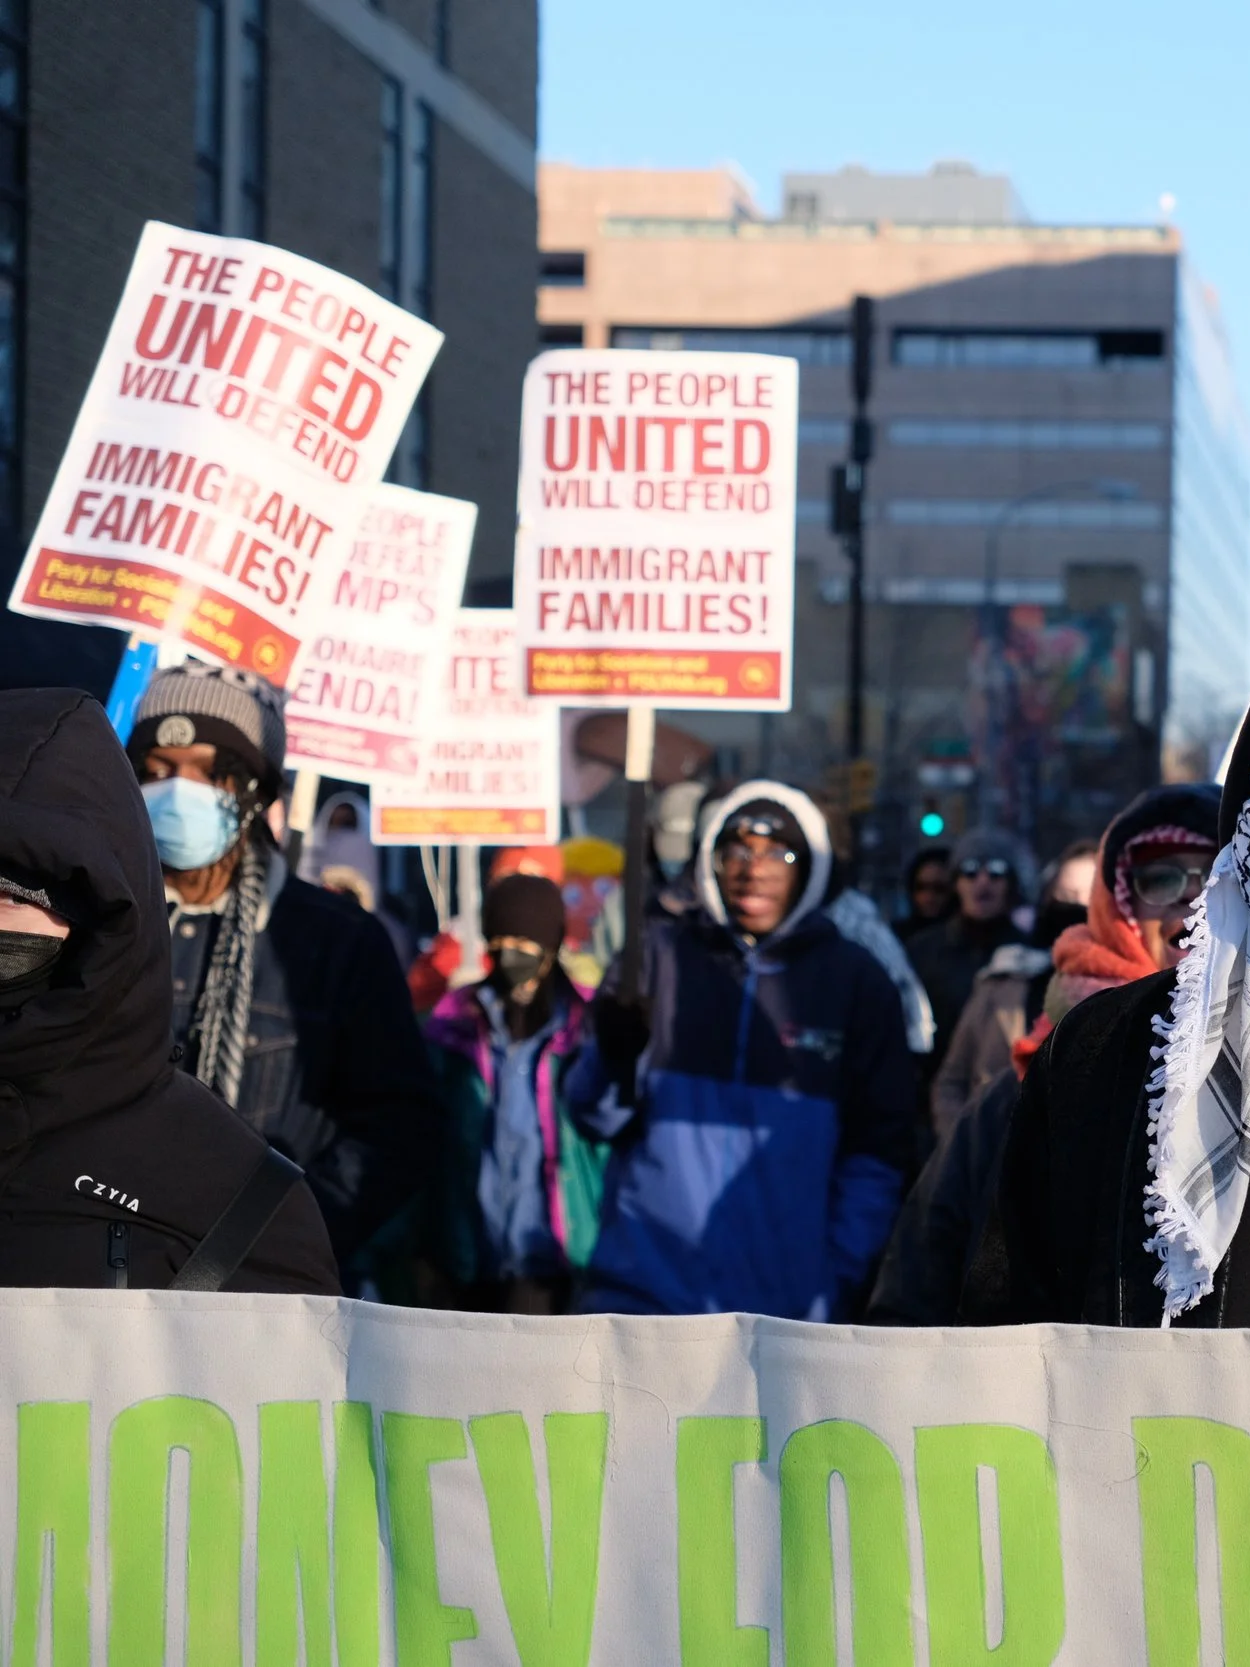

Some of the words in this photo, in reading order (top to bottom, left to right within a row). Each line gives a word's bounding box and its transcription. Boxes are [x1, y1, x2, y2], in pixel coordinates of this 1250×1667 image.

[163, 247, 243, 295] THE
[250, 267, 411, 378] PEOPLE
[135, 294, 384, 442] UNITED
[544, 371, 611, 405] THE
[628, 372, 773, 408] PEOPLE
[119, 362, 202, 408] WILL
[216, 383, 360, 484] DEFEND
[544, 416, 771, 475] UNITED
[85, 441, 333, 560] IMMIGRANT
[541, 479, 620, 510] WILL
[635, 479, 772, 513] DEFEND
[64, 490, 311, 615] FAMILIES!
[539, 547, 772, 584] IMMIGRANT
[538, 591, 769, 635] FAMILIES!
